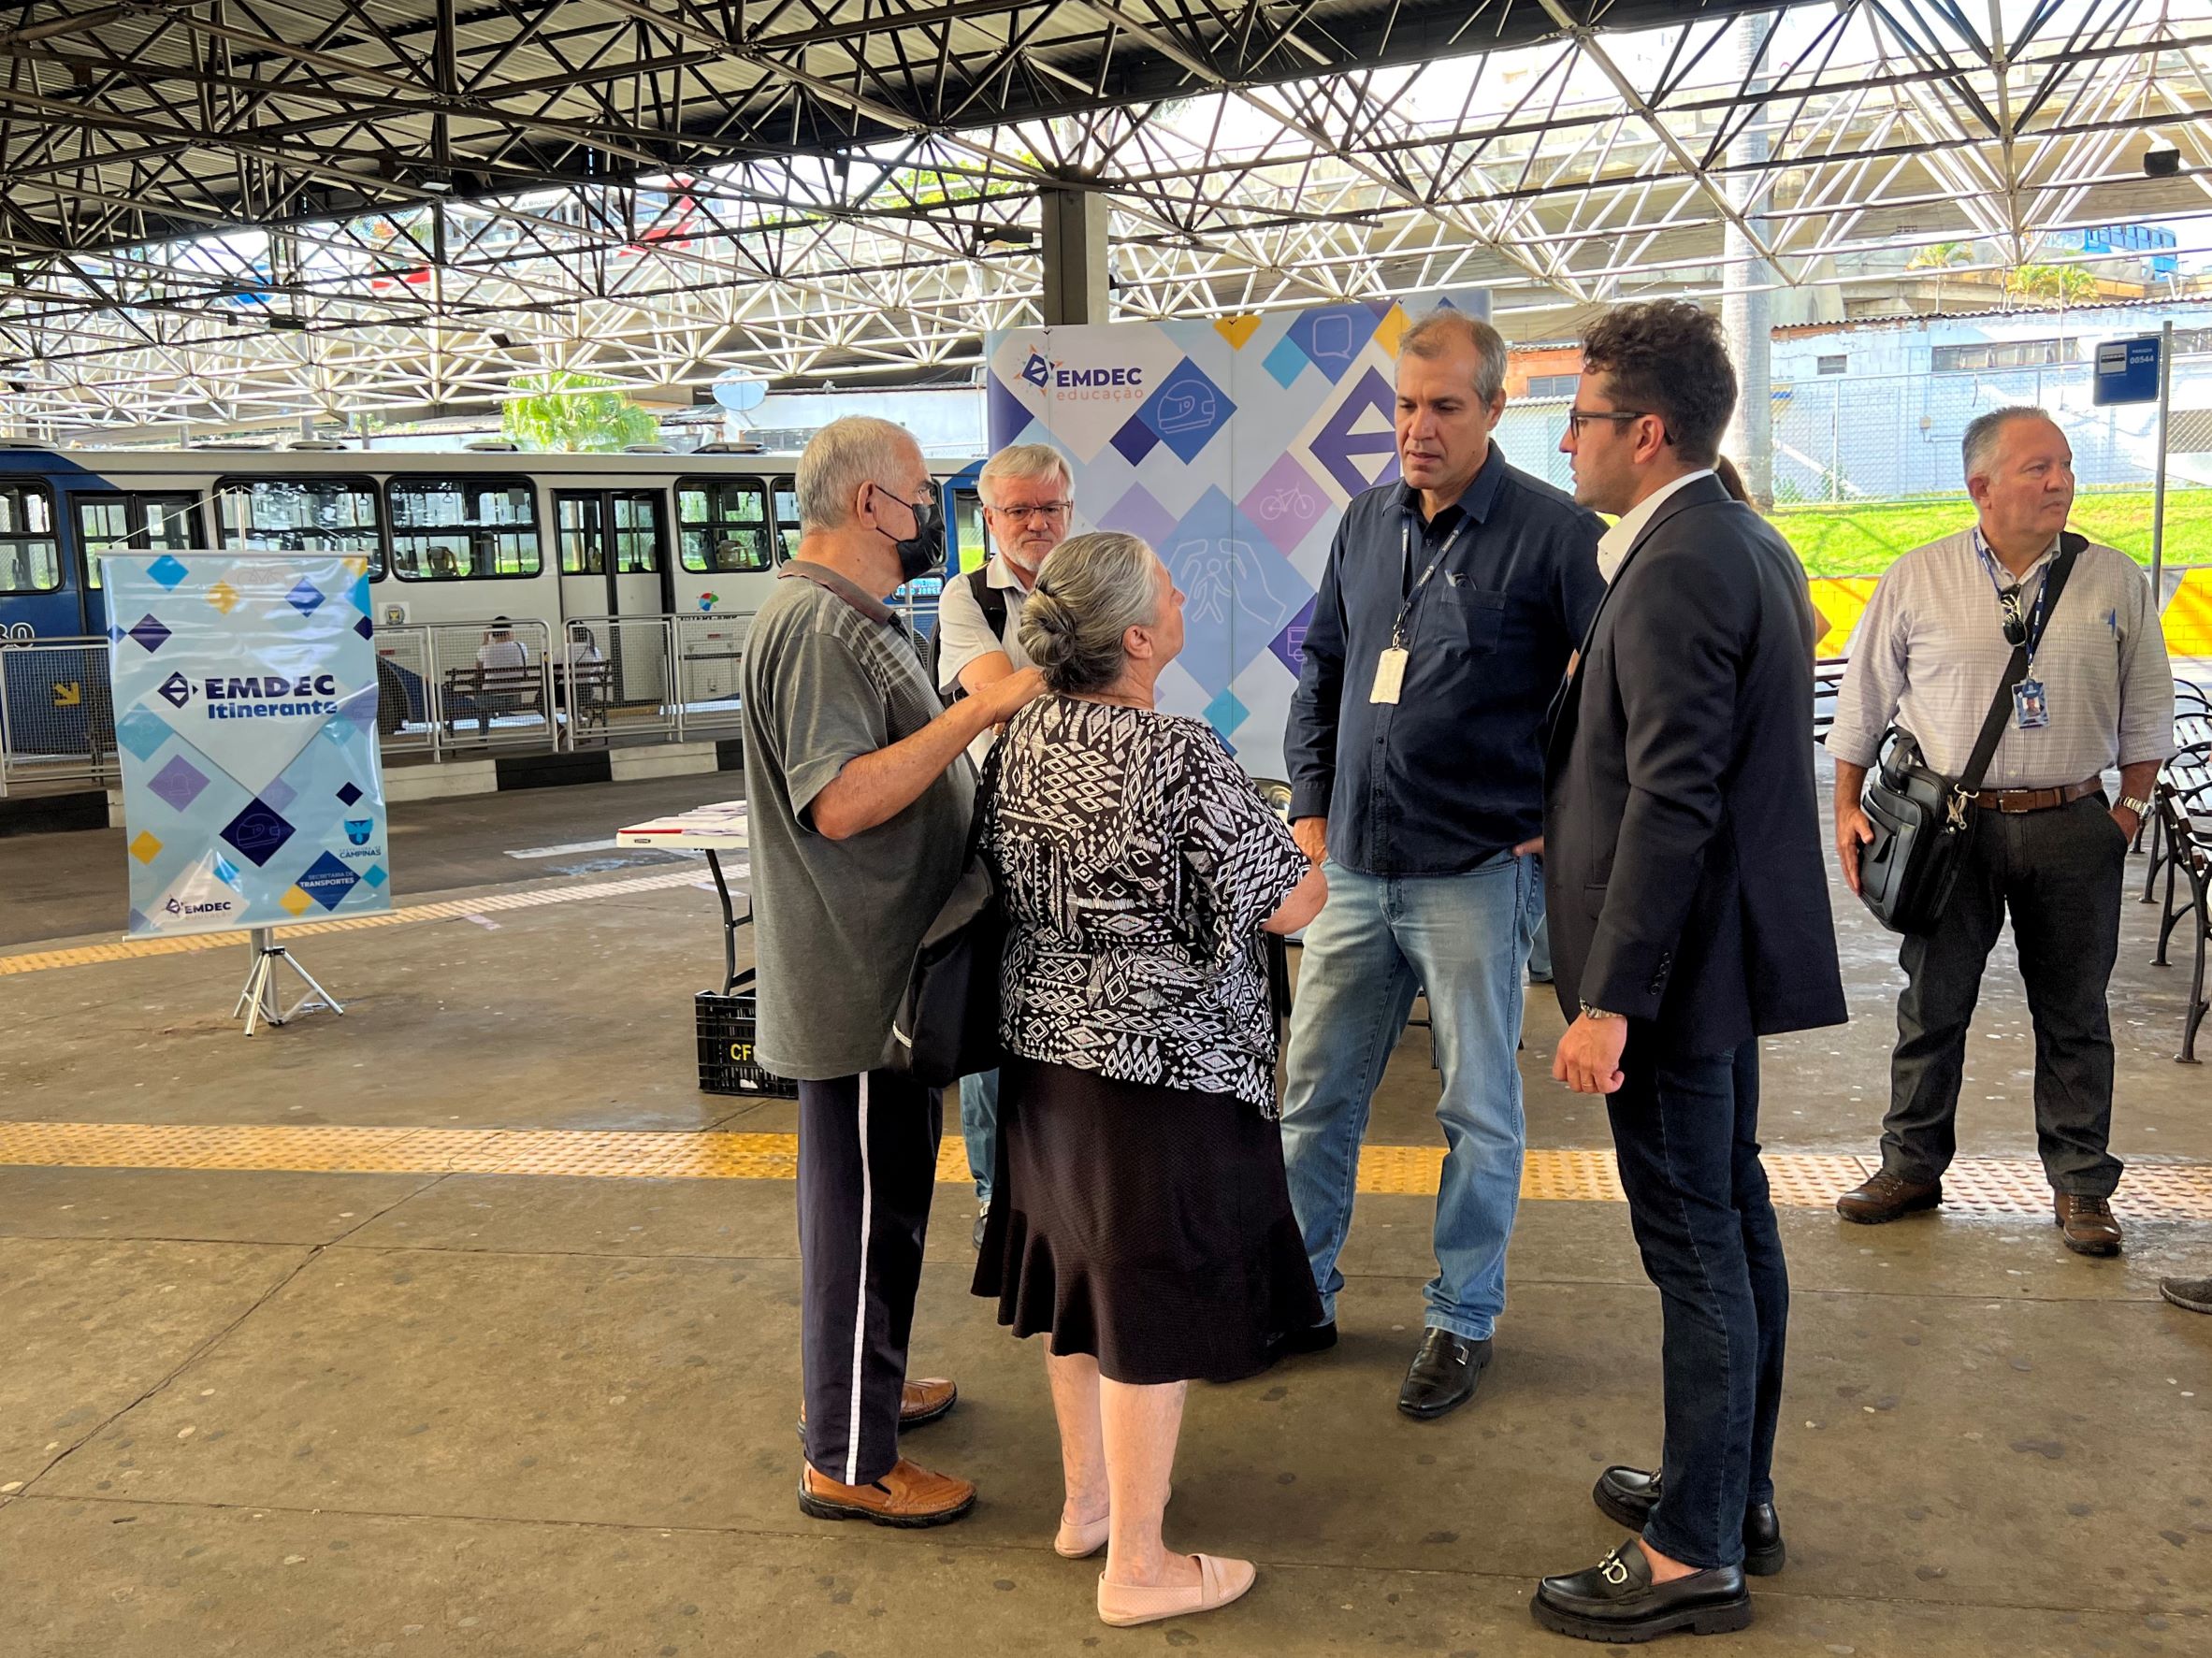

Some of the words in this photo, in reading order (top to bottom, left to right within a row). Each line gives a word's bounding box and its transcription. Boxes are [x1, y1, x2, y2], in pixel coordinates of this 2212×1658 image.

[1056, 368, 1143, 387] EMDEC
[1056, 386, 1144, 402] educação
[205, 674, 336, 699] EMDEC
[208, 699, 338, 719] Itinerante
[339, 849, 382, 858] CAMPINAS
[299, 877, 355, 887] TRANSPORTES
[184, 901, 232, 914] EMDEC
